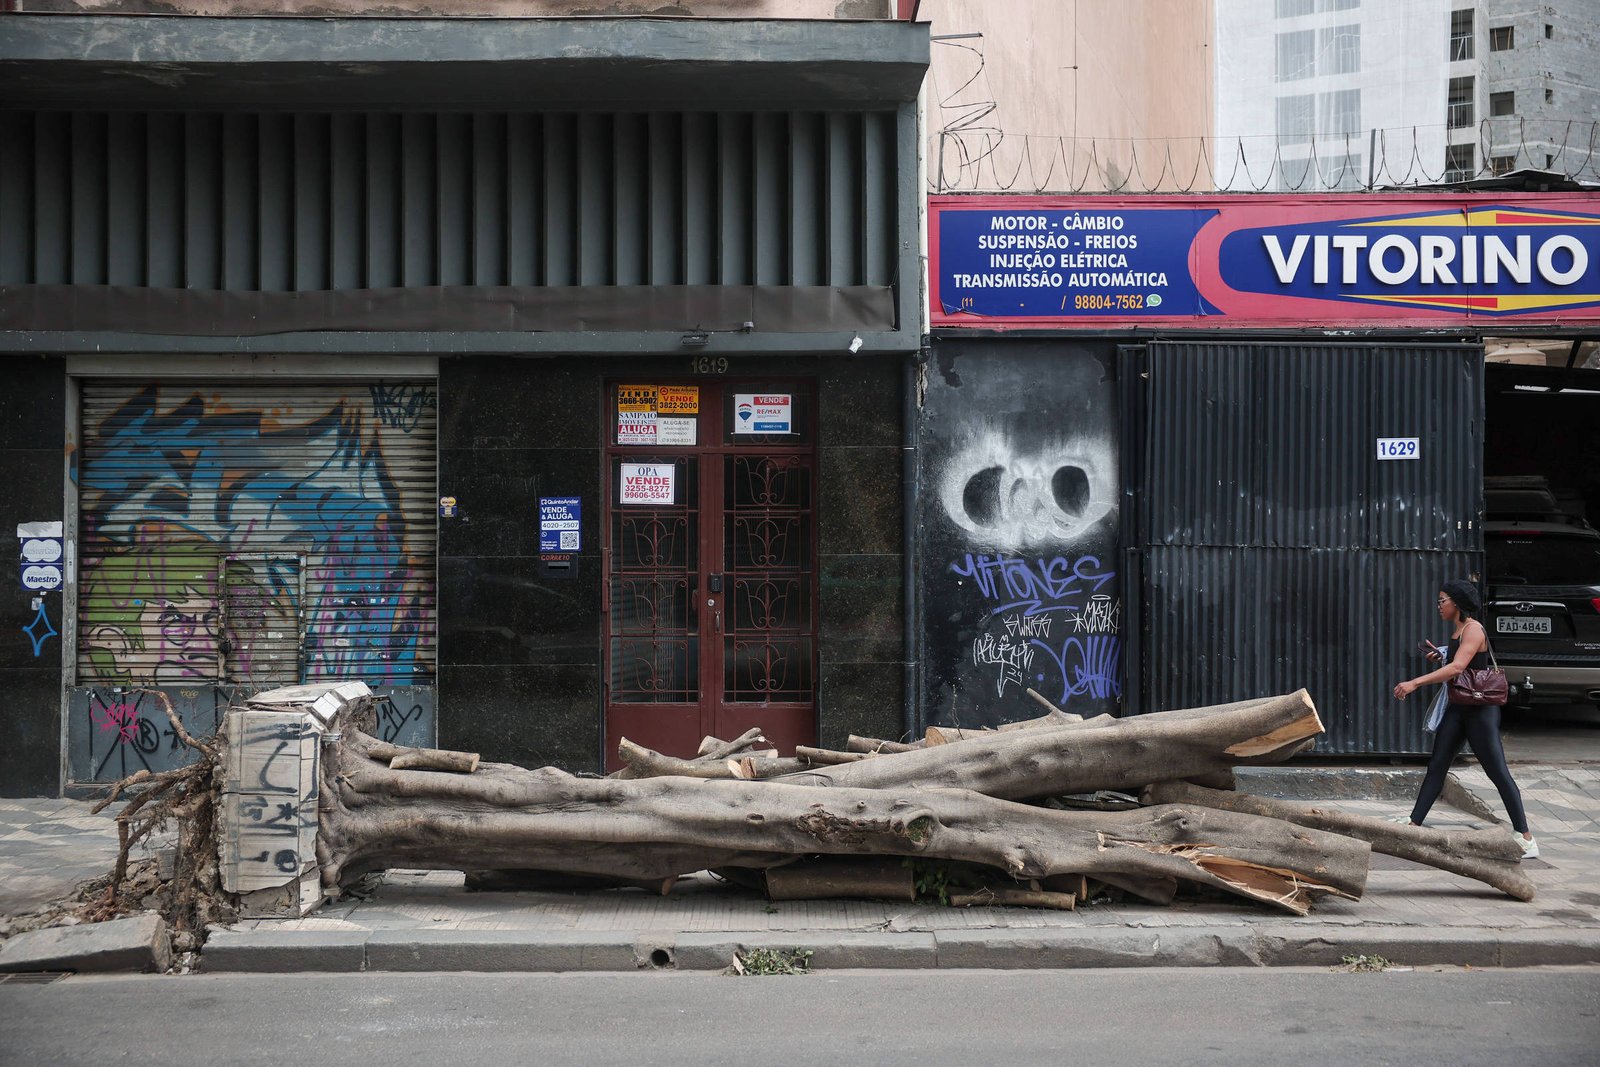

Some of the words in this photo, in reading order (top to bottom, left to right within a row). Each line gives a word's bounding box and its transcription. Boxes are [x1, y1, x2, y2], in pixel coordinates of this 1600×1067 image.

[991, 216, 1047, 230] MOTOR
[1063, 213, 1124, 230] CÂMBIO
[978, 232, 1069, 249] SUSPENSÃO
[1085, 235, 1137, 249] FREIOS
[990, 251, 1055, 271] INJEÇÃO
[1060, 252, 1128, 268] ELÉTRICA
[1262, 234, 1588, 286] VITORINO
[953, 270, 1063, 288] TRANSMISSÃO
[1068, 270, 1168, 287] AUTOMÁTICA
[1075, 295, 1143, 309] 98804-7562
[691, 356, 729, 374] 1619
[620, 425, 655, 434] ALUGA
[1380, 441, 1416, 456] 1629
[638, 467, 658, 476] OPA
[625, 477, 670, 485] VENDE
[547, 512, 573, 520] ALUGA
